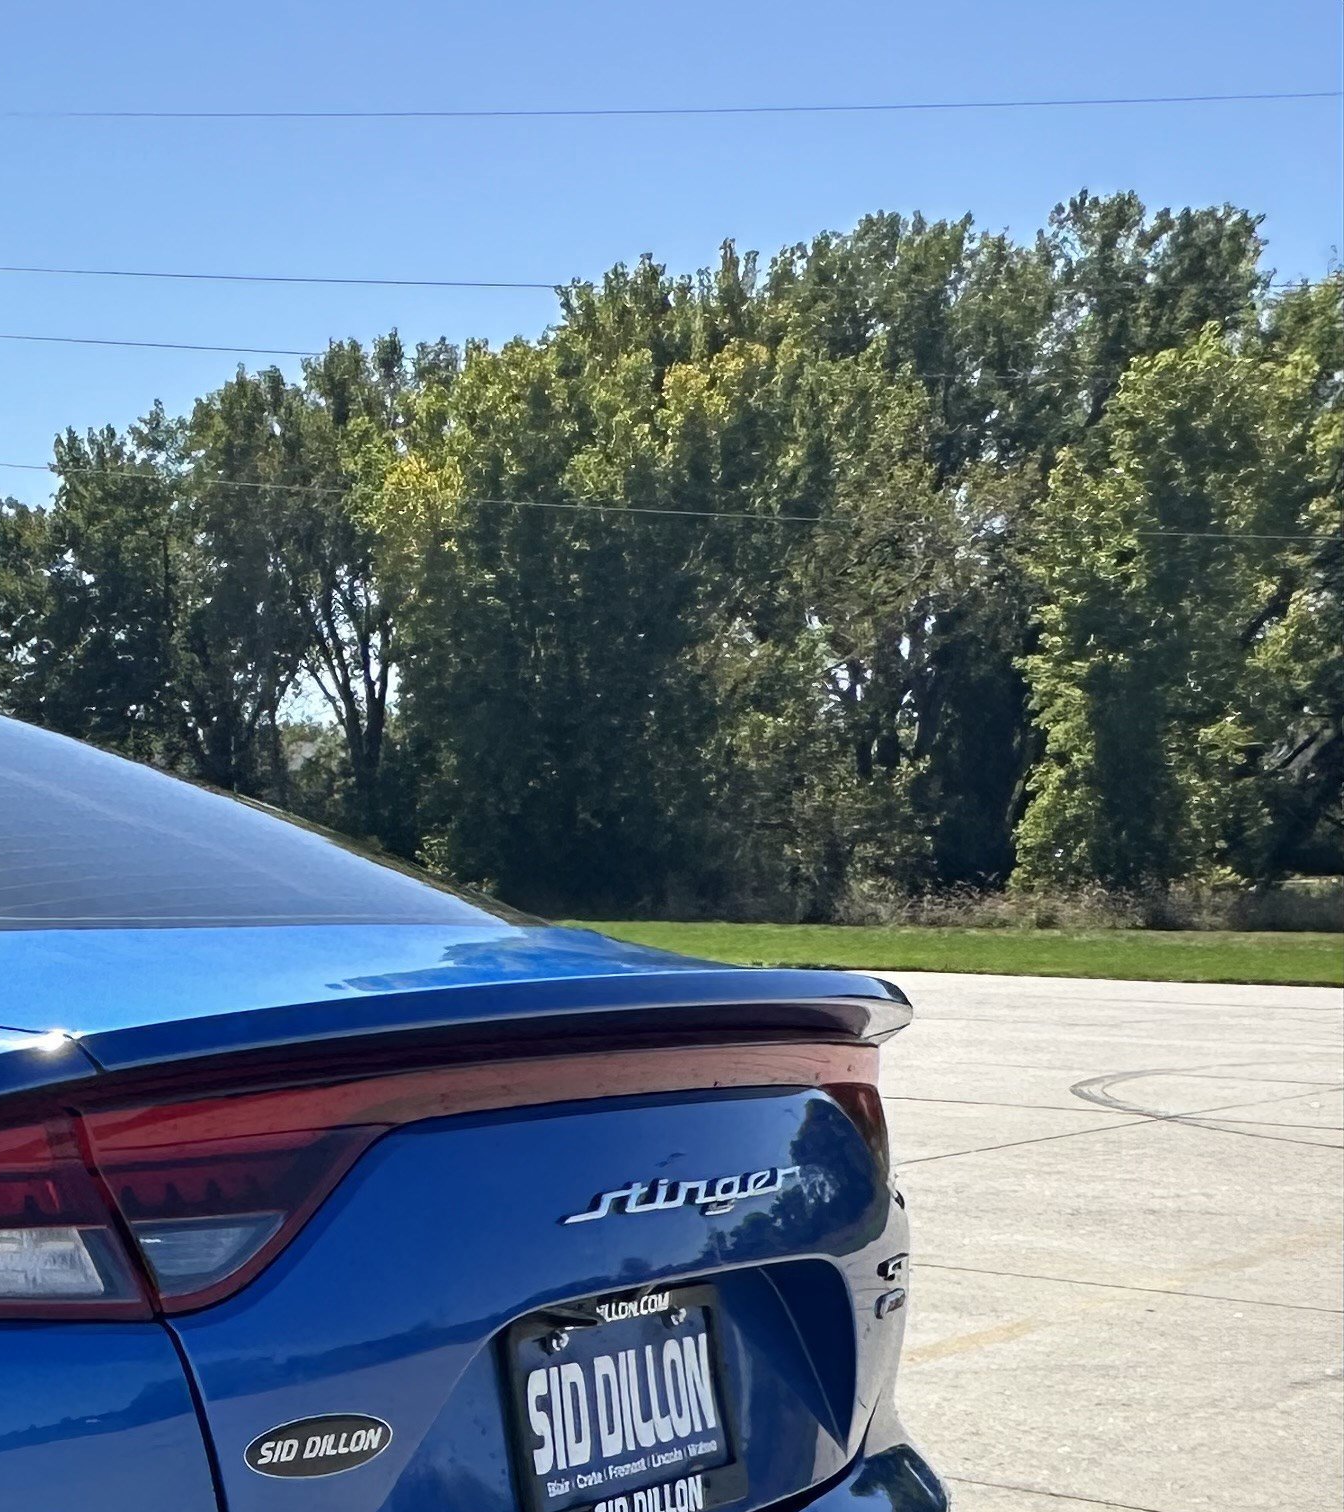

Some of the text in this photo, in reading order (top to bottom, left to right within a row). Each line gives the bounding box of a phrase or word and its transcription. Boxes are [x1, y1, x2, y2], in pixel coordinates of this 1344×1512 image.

[256, 1426, 383, 1465] SID DILLON
[526, 1332, 717, 1476] SID DILLON
